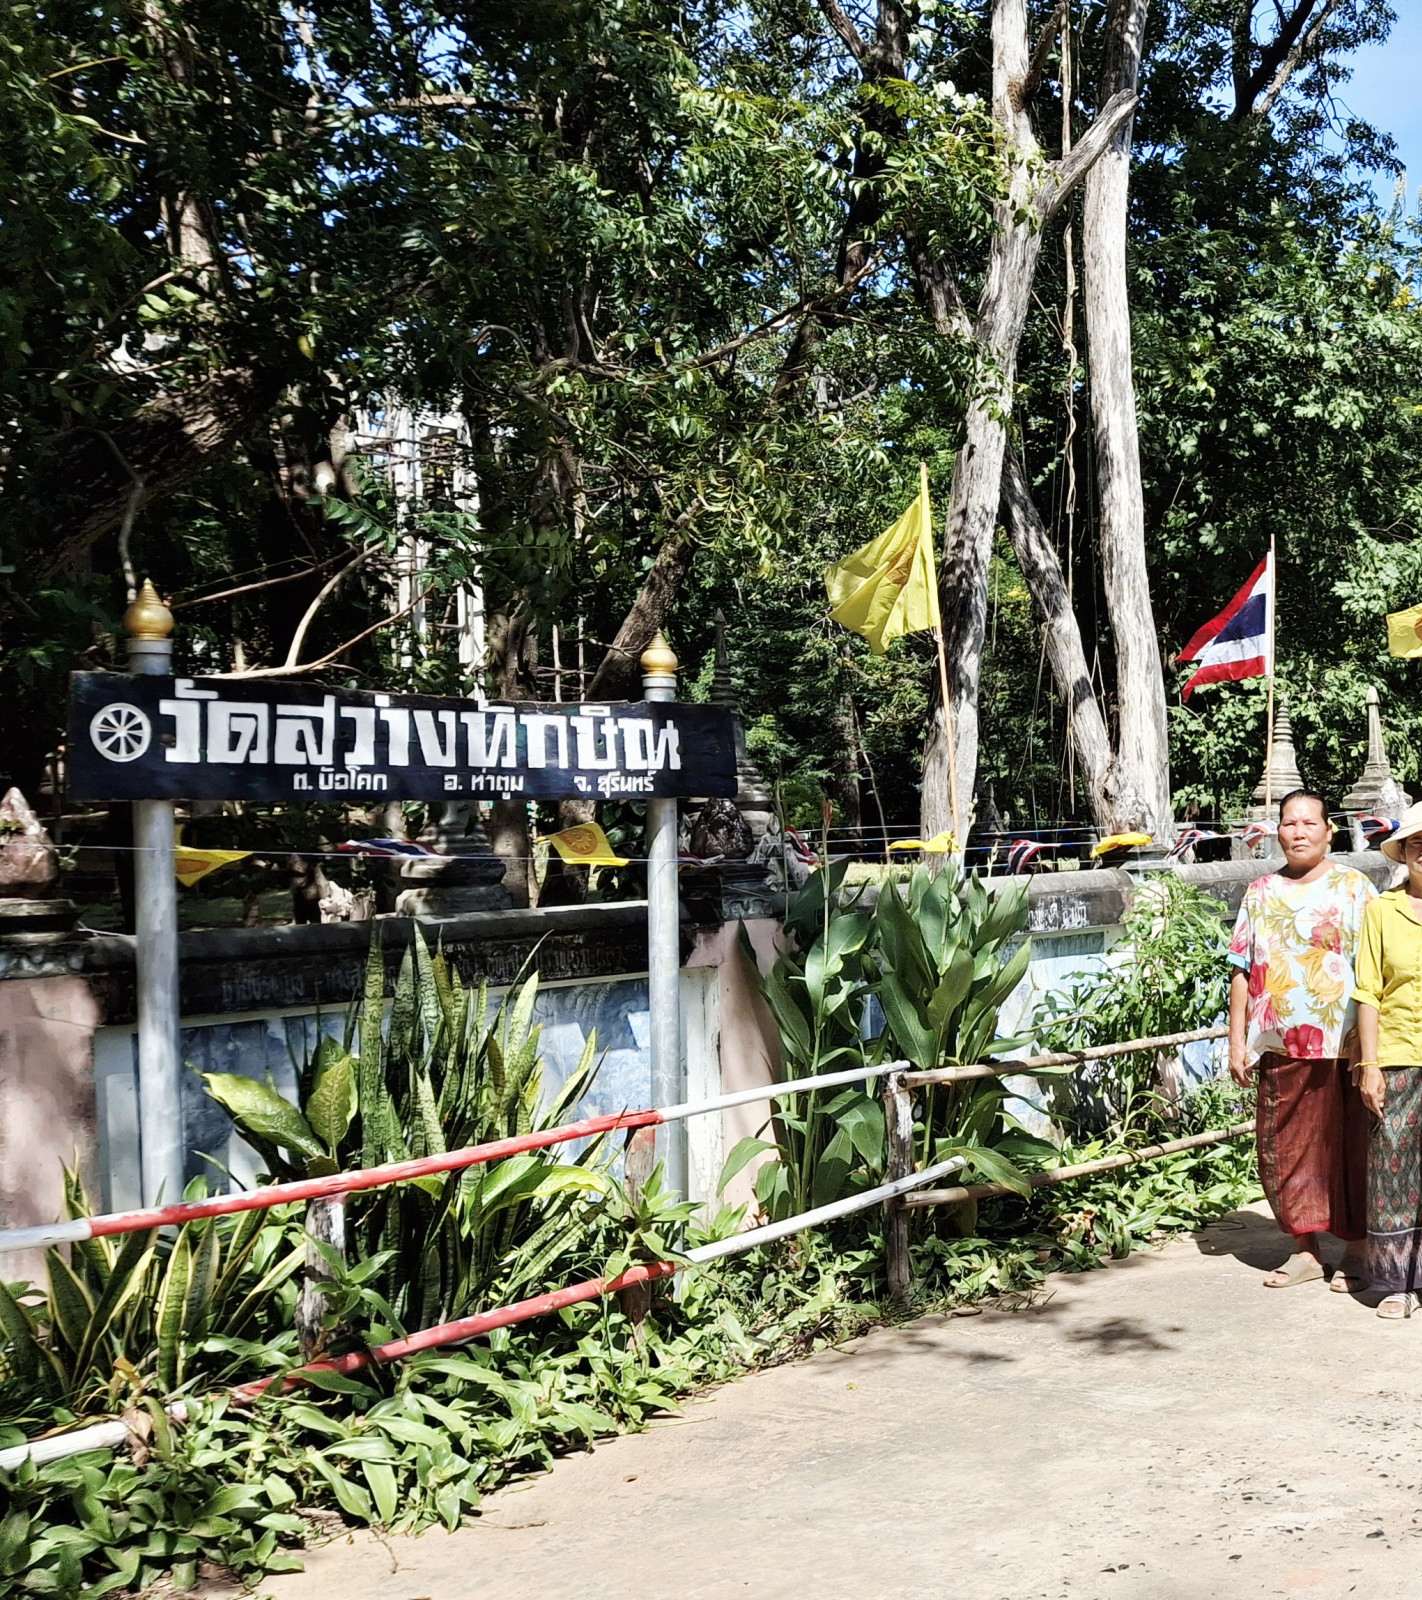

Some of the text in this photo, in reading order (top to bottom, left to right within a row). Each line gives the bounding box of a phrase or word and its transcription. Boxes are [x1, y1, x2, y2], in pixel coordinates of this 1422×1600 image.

[159, 679, 681, 769] วัดสว่างทักษิณ
[319, 764, 388, 791] บัวโคก
[444, 775, 463, 791] อ.
[471, 767, 524, 800] ท่าตูม
[574, 776, 592, 792] จ.
[597, 769, 656, 798] สุรินทร์
